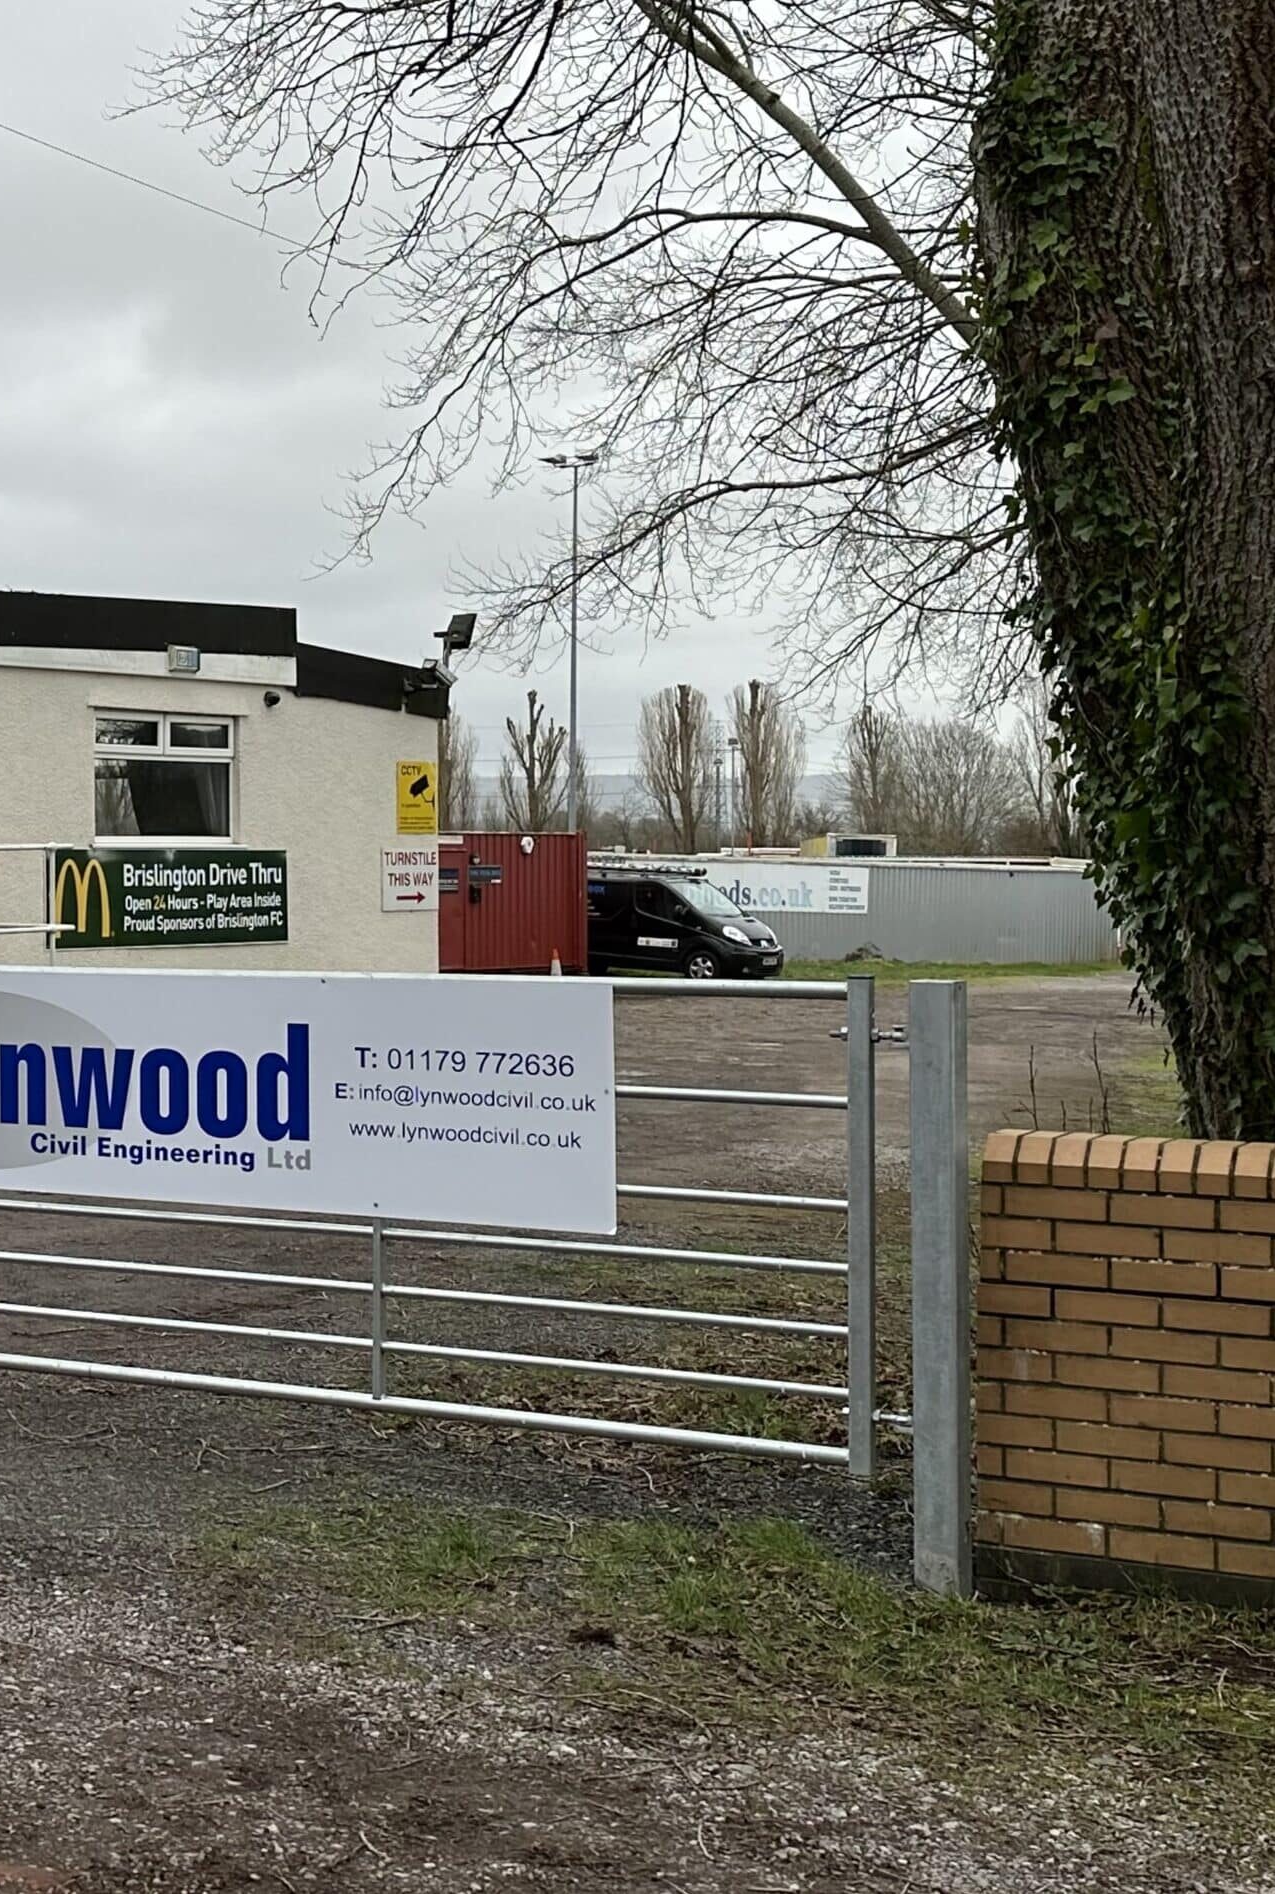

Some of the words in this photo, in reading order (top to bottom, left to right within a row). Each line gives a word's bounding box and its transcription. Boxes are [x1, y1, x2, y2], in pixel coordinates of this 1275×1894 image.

[401, 765, 422, 776] CCTV
[384, 851, 437, 866] TURNSTILE
[123, 863, 206, 892] Brislington
[209, 862, 248, 886] Drive
[249, 862, 283, 885] Thru
[388, 873, 411, 887] THIS
[414, 873, 434, 887] WAY
[125, 895, 152, 914] Open
[153, 895, 166, 910] 24
[168, 894, 199, 910] Hours
[207, 894, 228, 912] Play
[229, 893, 252, 908] Area
[254, 892, 281, 908] Inside
[124, 915, 156, 932] Proud
[156, 915, 204, 934] Sponsors
[205, 914, 216, 929] of
[217, 913, 269, 931] Brislington
[270, 912, 283, 927] FC
[354, 1047, 377, 1069] T:
[387, 1048, 466, 1073] 01179
[475, 1052, 575, 1077] 772636
[335, 1083, 355, 1100] E:
[358, 1083, 596, 1112] info@lynwoodcivil.co.uk
[349, 1122, 582, 1150] www.lynwoodcivil.co.uk
[30, 1132, 87, 1156] Civil
[98, 1137, 256, 1172] Engineering
[267, 1147, 312, 1171] Ltd
